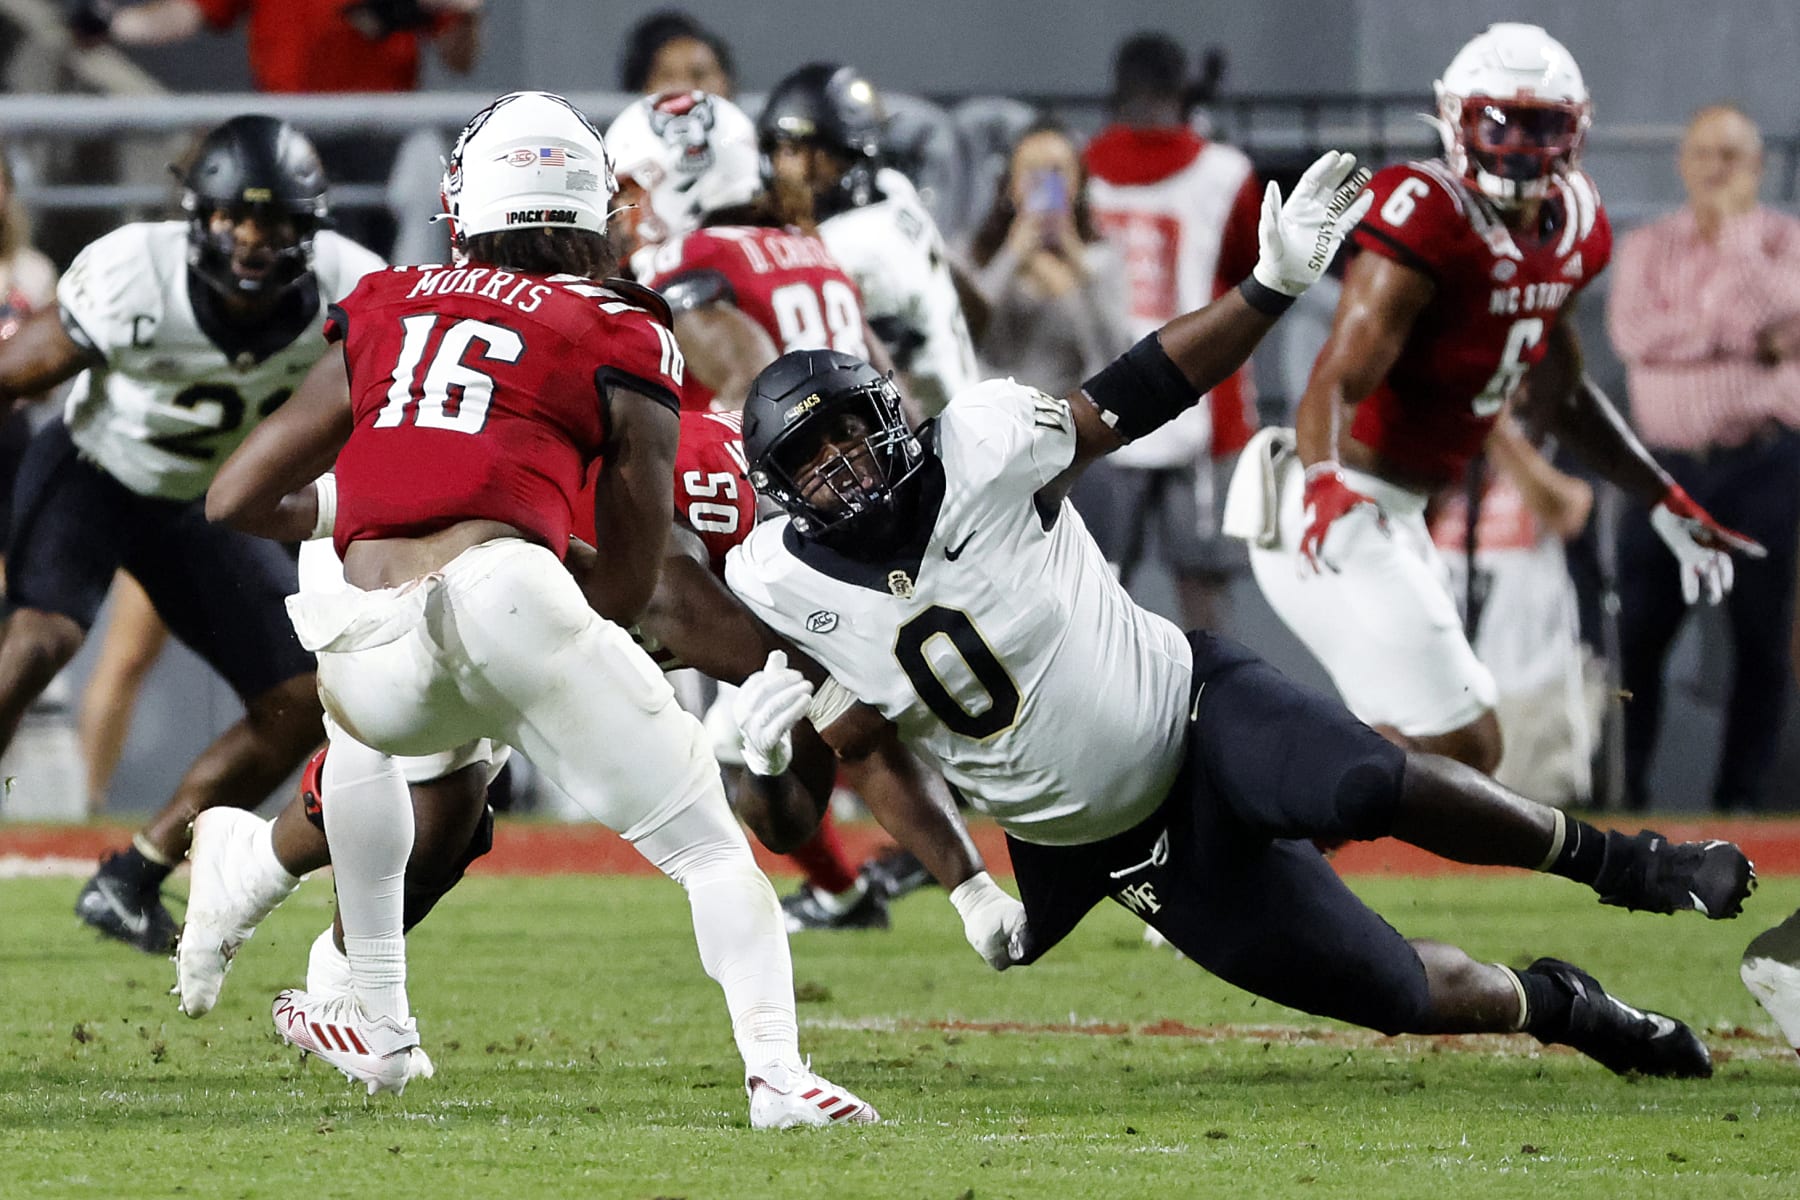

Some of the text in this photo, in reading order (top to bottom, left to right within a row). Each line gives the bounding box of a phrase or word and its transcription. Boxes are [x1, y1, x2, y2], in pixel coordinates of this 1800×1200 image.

[1380, 177, 1430, 228] 6
[405, 267, 552, 313] MORRIS
[1488, 286, 1521, 315] NC
[133, 314, 156, 350] C
[373, 312, 527, 435] 16
[1471, 317, 1545, 419] 6
[792, 393, 821, 417] DEACS
[683, 470, 739, 534] 50
[891, 601, 1024, 741] 0
[1118, 881, 1162, 914] WF
